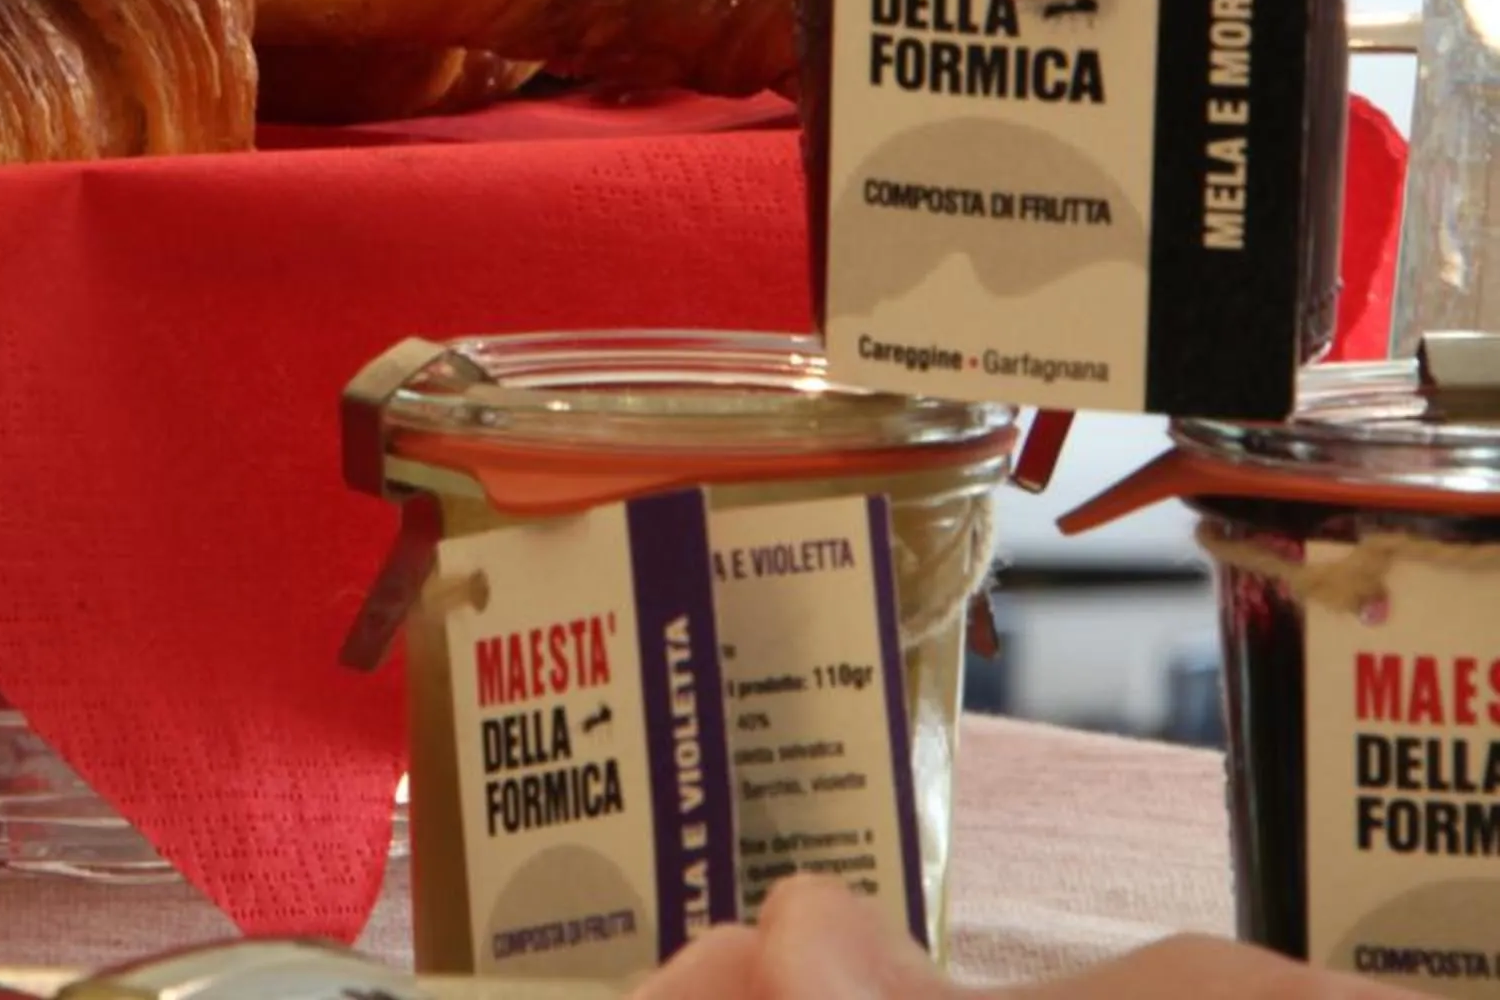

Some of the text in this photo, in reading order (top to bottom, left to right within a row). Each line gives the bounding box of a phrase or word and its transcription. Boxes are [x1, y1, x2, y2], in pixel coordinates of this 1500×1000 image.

[868, 31, 1106, 105] FORMICA
[1207, 98, 1249, 125] E
[863, 178, 1113, 226] COMPOSTA DI FRUTTA
[1203, 136, 1248, 250] MELA
[857, 333, 1110, 384] Careggine Garfagnana
[731, 547, 748, 581] E
[750, 536, 856, 579] VIOLETTA
[475, 609, 617, 708] MAESTA'
[481, 703, 573, 777] DELLA
[664, 612, 706, 814] VIOLETTA
[486, 756, 625, 839] FORMICA
[1357, 796, 1500, 856] FORM
[681, 820, 708, 850] E
[1354, 944, 1490, 980] COMPOSTA
